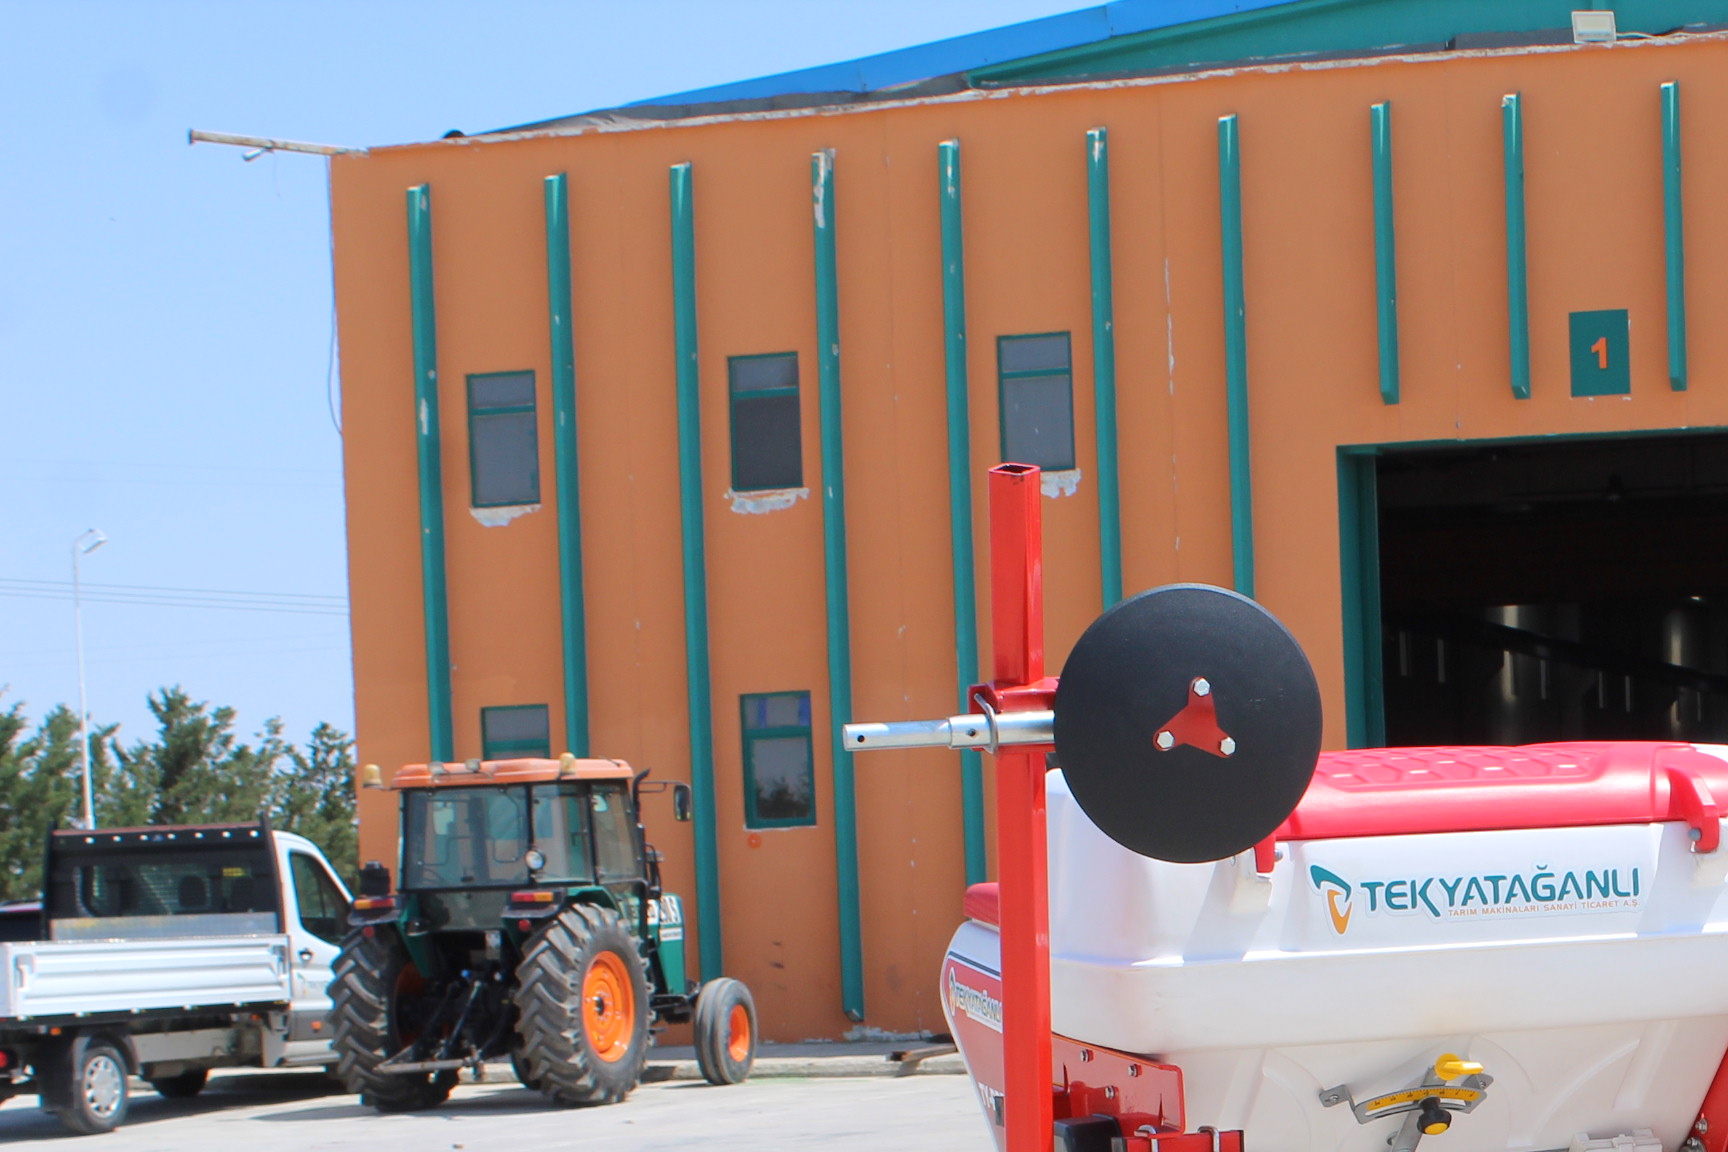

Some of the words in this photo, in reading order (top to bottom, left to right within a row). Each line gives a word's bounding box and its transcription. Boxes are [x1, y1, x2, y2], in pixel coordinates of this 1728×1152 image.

[1591, 337, 1608, 369] 1
[1360, 863, 1640, 917] TEKYATAĞANLI
[1448, 908, 1478, 917] TARIM
[1543, 901, 1578, 911] SANAYİ
[1582, 899, 1619, 909] TİCARET
